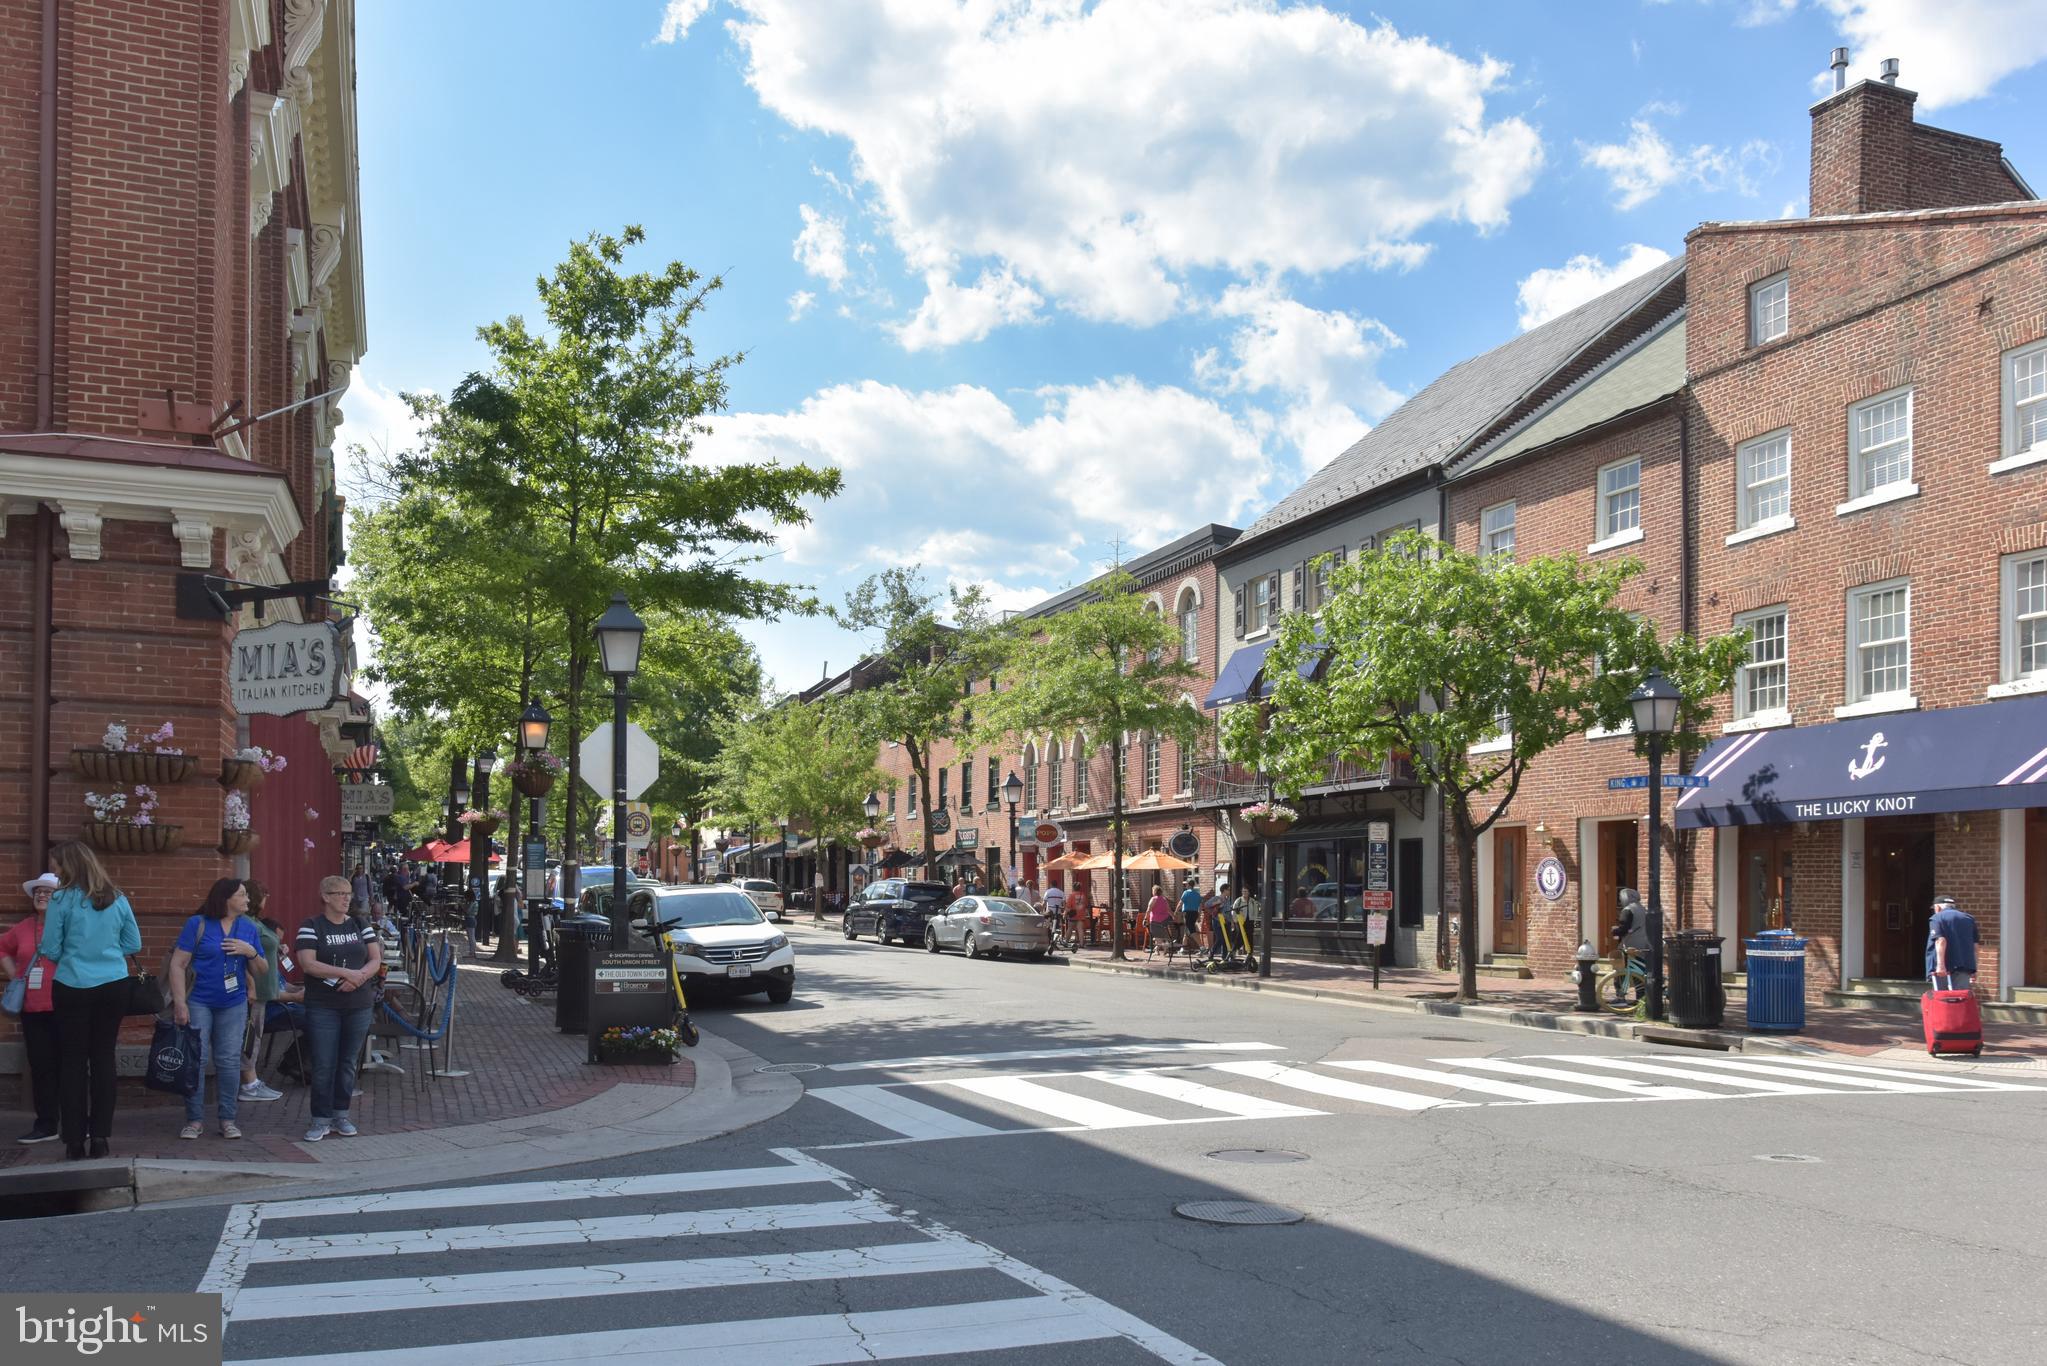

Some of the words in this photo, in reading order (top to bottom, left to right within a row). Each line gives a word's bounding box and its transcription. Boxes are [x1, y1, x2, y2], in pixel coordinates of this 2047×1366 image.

[238, 638, 326, 682] MIA'S
[238, 687, 276, 701] ITALIAN
[281, 682, 325, 698] KITCHEN
[1610, 778, 1625, 789] KING
[1669, 776, 1685, 786] UNION
[343, 789, 391, 804] MIA'S
[1795, 803, 1822, 817] THE
[1826, 799, 1871, 815] LUCKY
[1875, 796, 1917, 812] KNOT
[1375, 843, 1382, 852] P
[326, 933, 358, 944] STRONG
